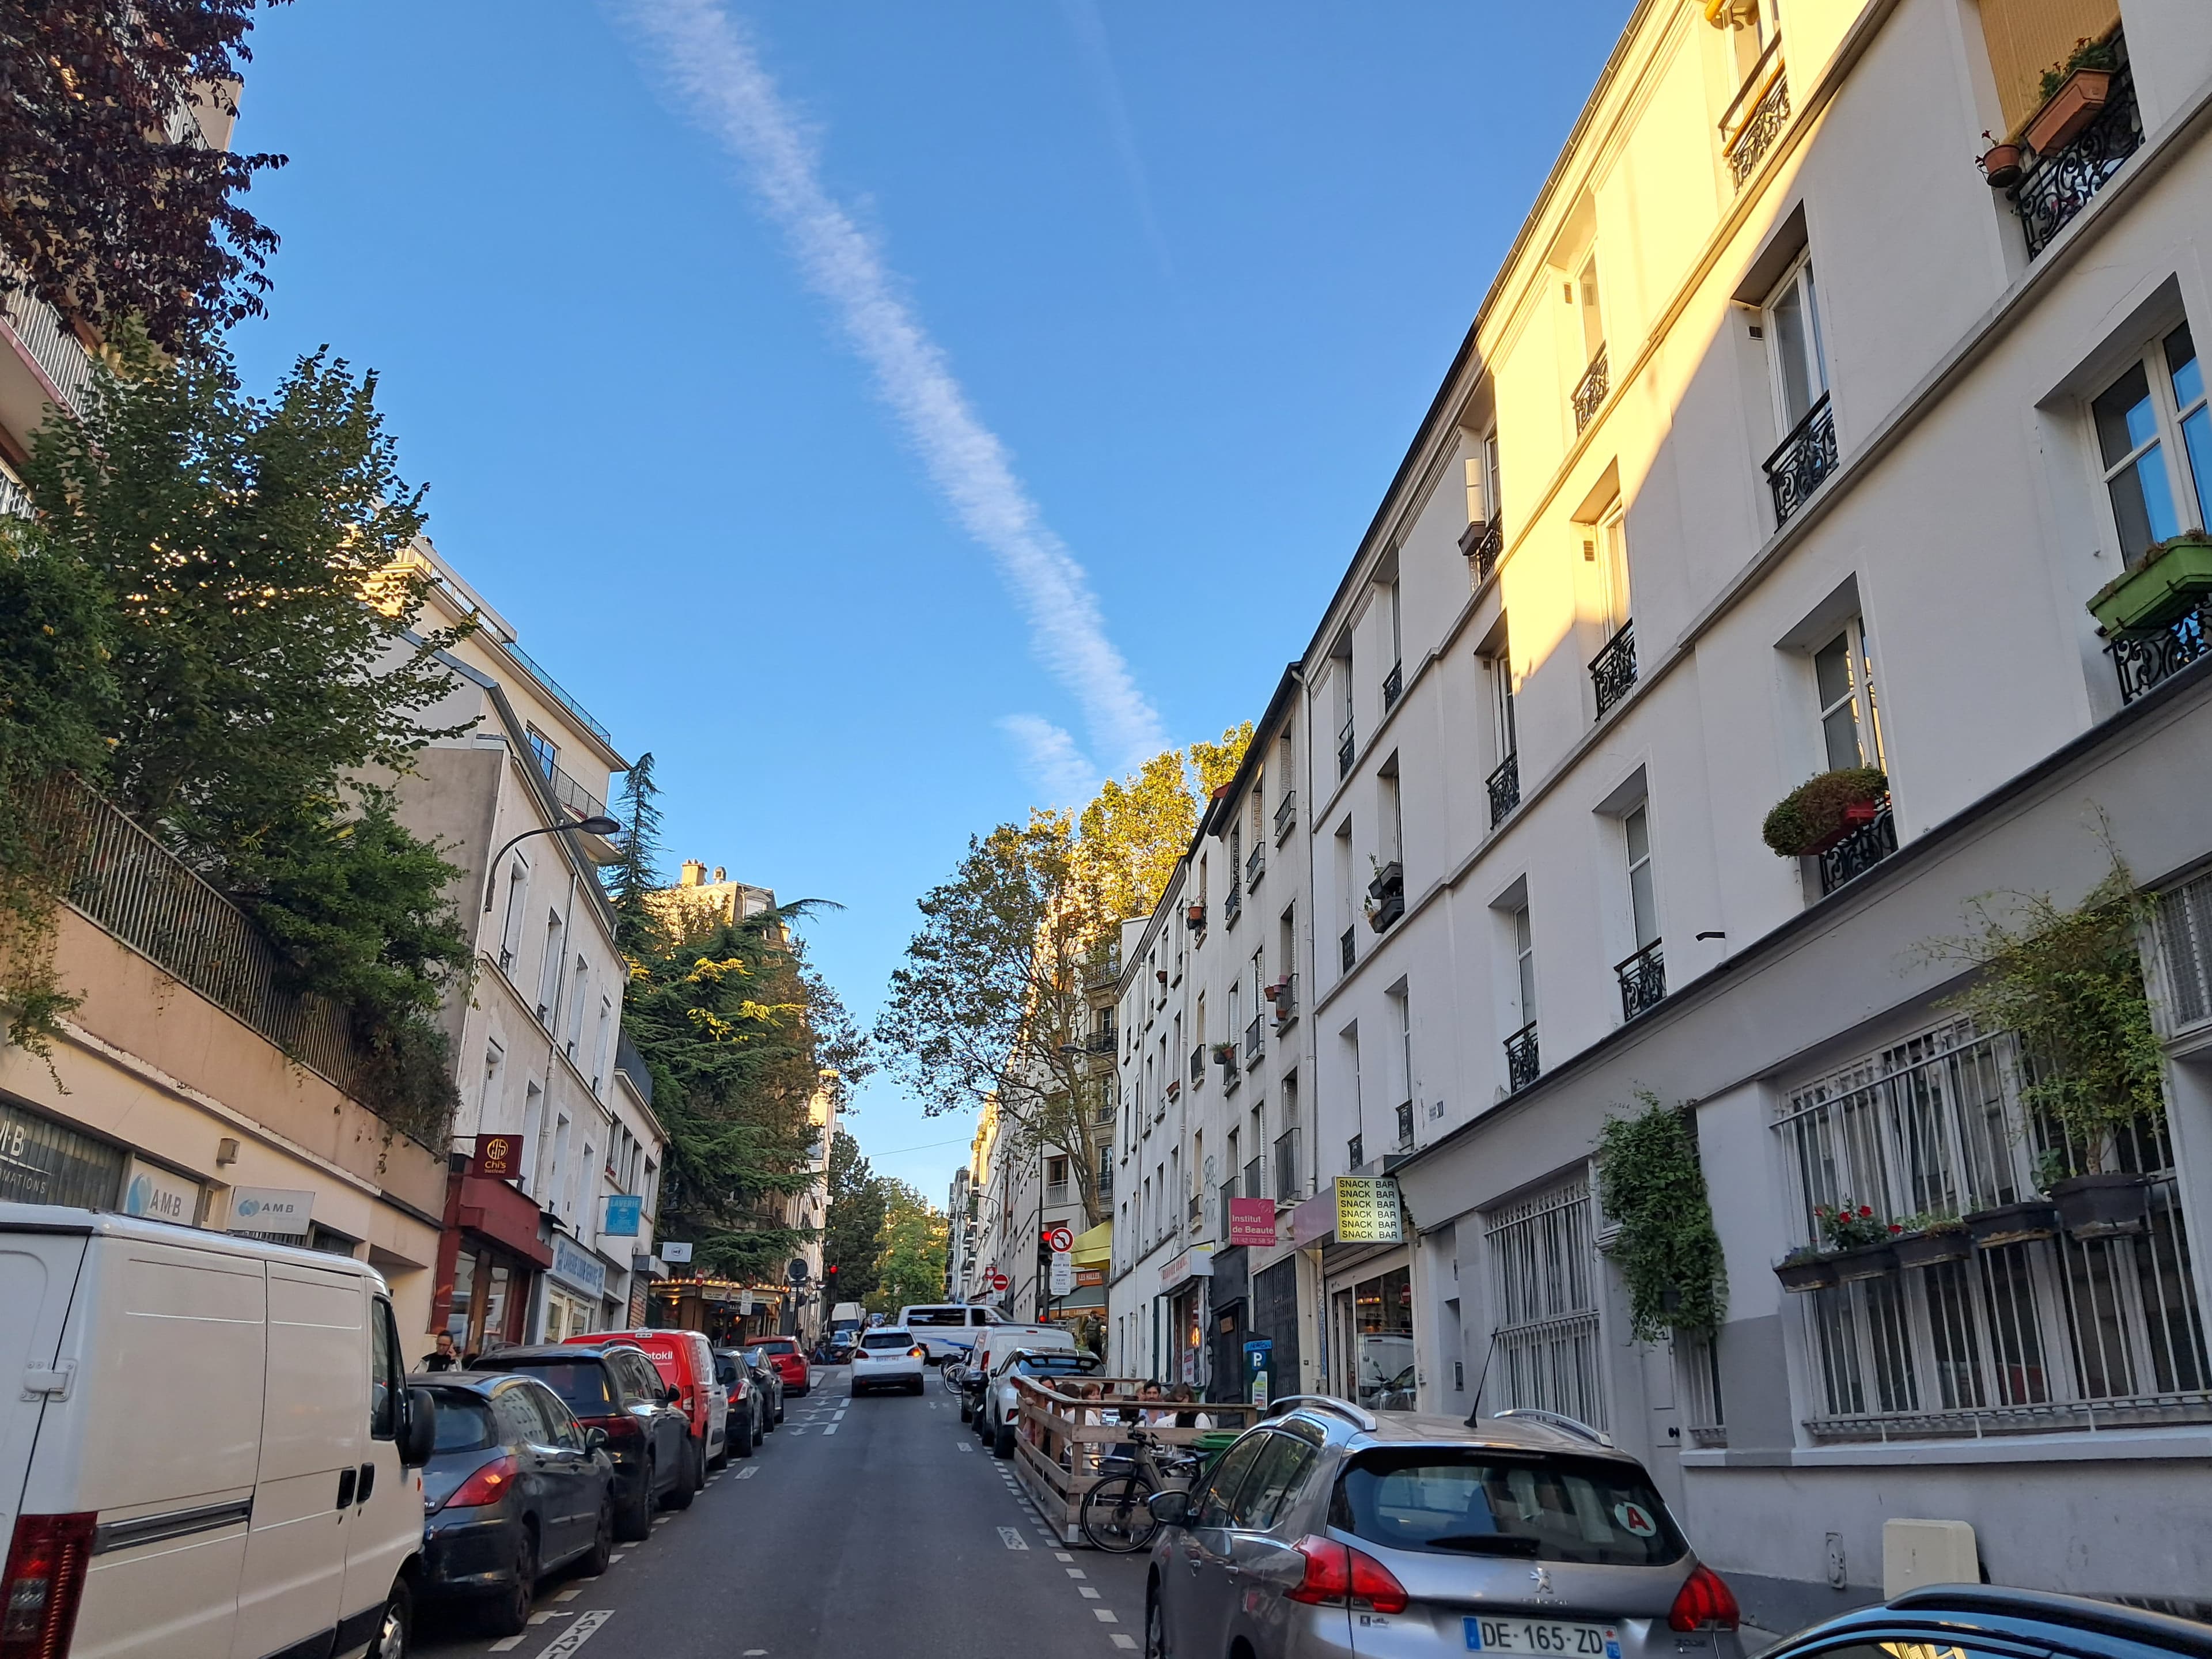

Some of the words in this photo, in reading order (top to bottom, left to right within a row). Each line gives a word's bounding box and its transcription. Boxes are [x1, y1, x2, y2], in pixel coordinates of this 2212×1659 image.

[0, 1168, 46, 1194] MATIONS
[1339, 1180, 1370, 1188] SNACK
[262, 1203, 294, 1213] AMB
[1340, 1200, 1371, 1208] SNACK
[1232, 1215, 1261, 1223] Institut
[1342, 1220, 1373, 1228] SNACK
[1627, 1506, 1652, 1531] A
[1608, 1646, 1619, 1656] 75
